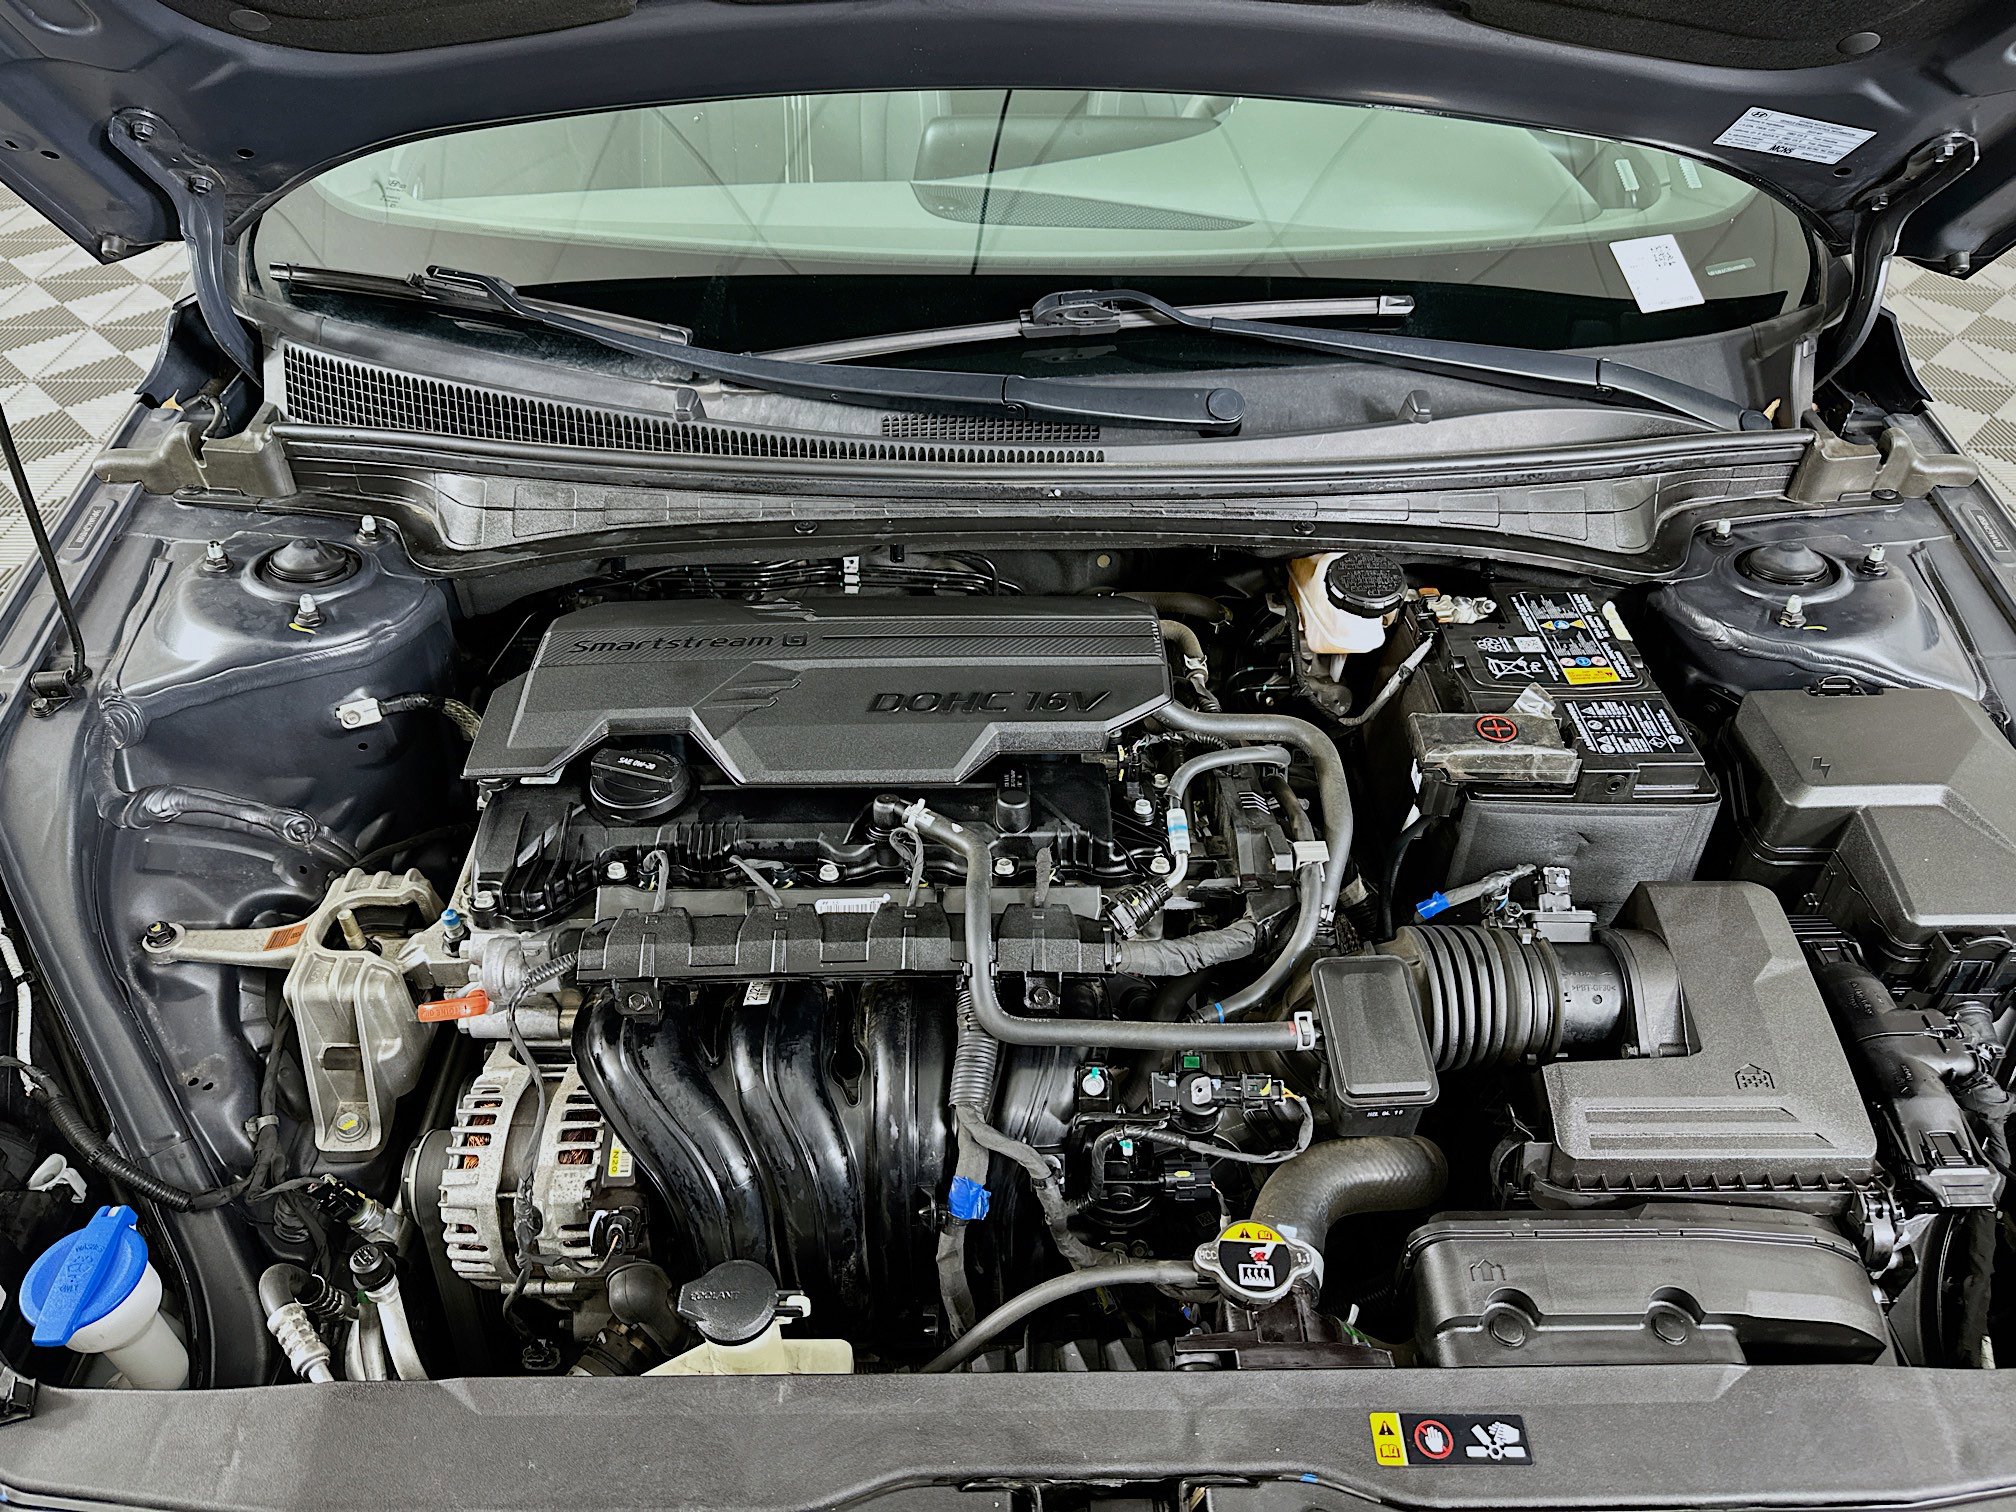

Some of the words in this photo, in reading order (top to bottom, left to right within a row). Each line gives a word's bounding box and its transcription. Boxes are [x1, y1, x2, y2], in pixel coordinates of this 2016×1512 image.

[569, 636, 775, 652] Smartstream
[867, 692, 1014, 712] DOHC
[1025, 691, 1111, 712] 16V
[618, 757, 633, 766] SAE
[633, 760, 656, 770] 0W-20
[1199, 1250, 1218, 1260] HCC
[690, 1291, 740, 1301] COOLANT
